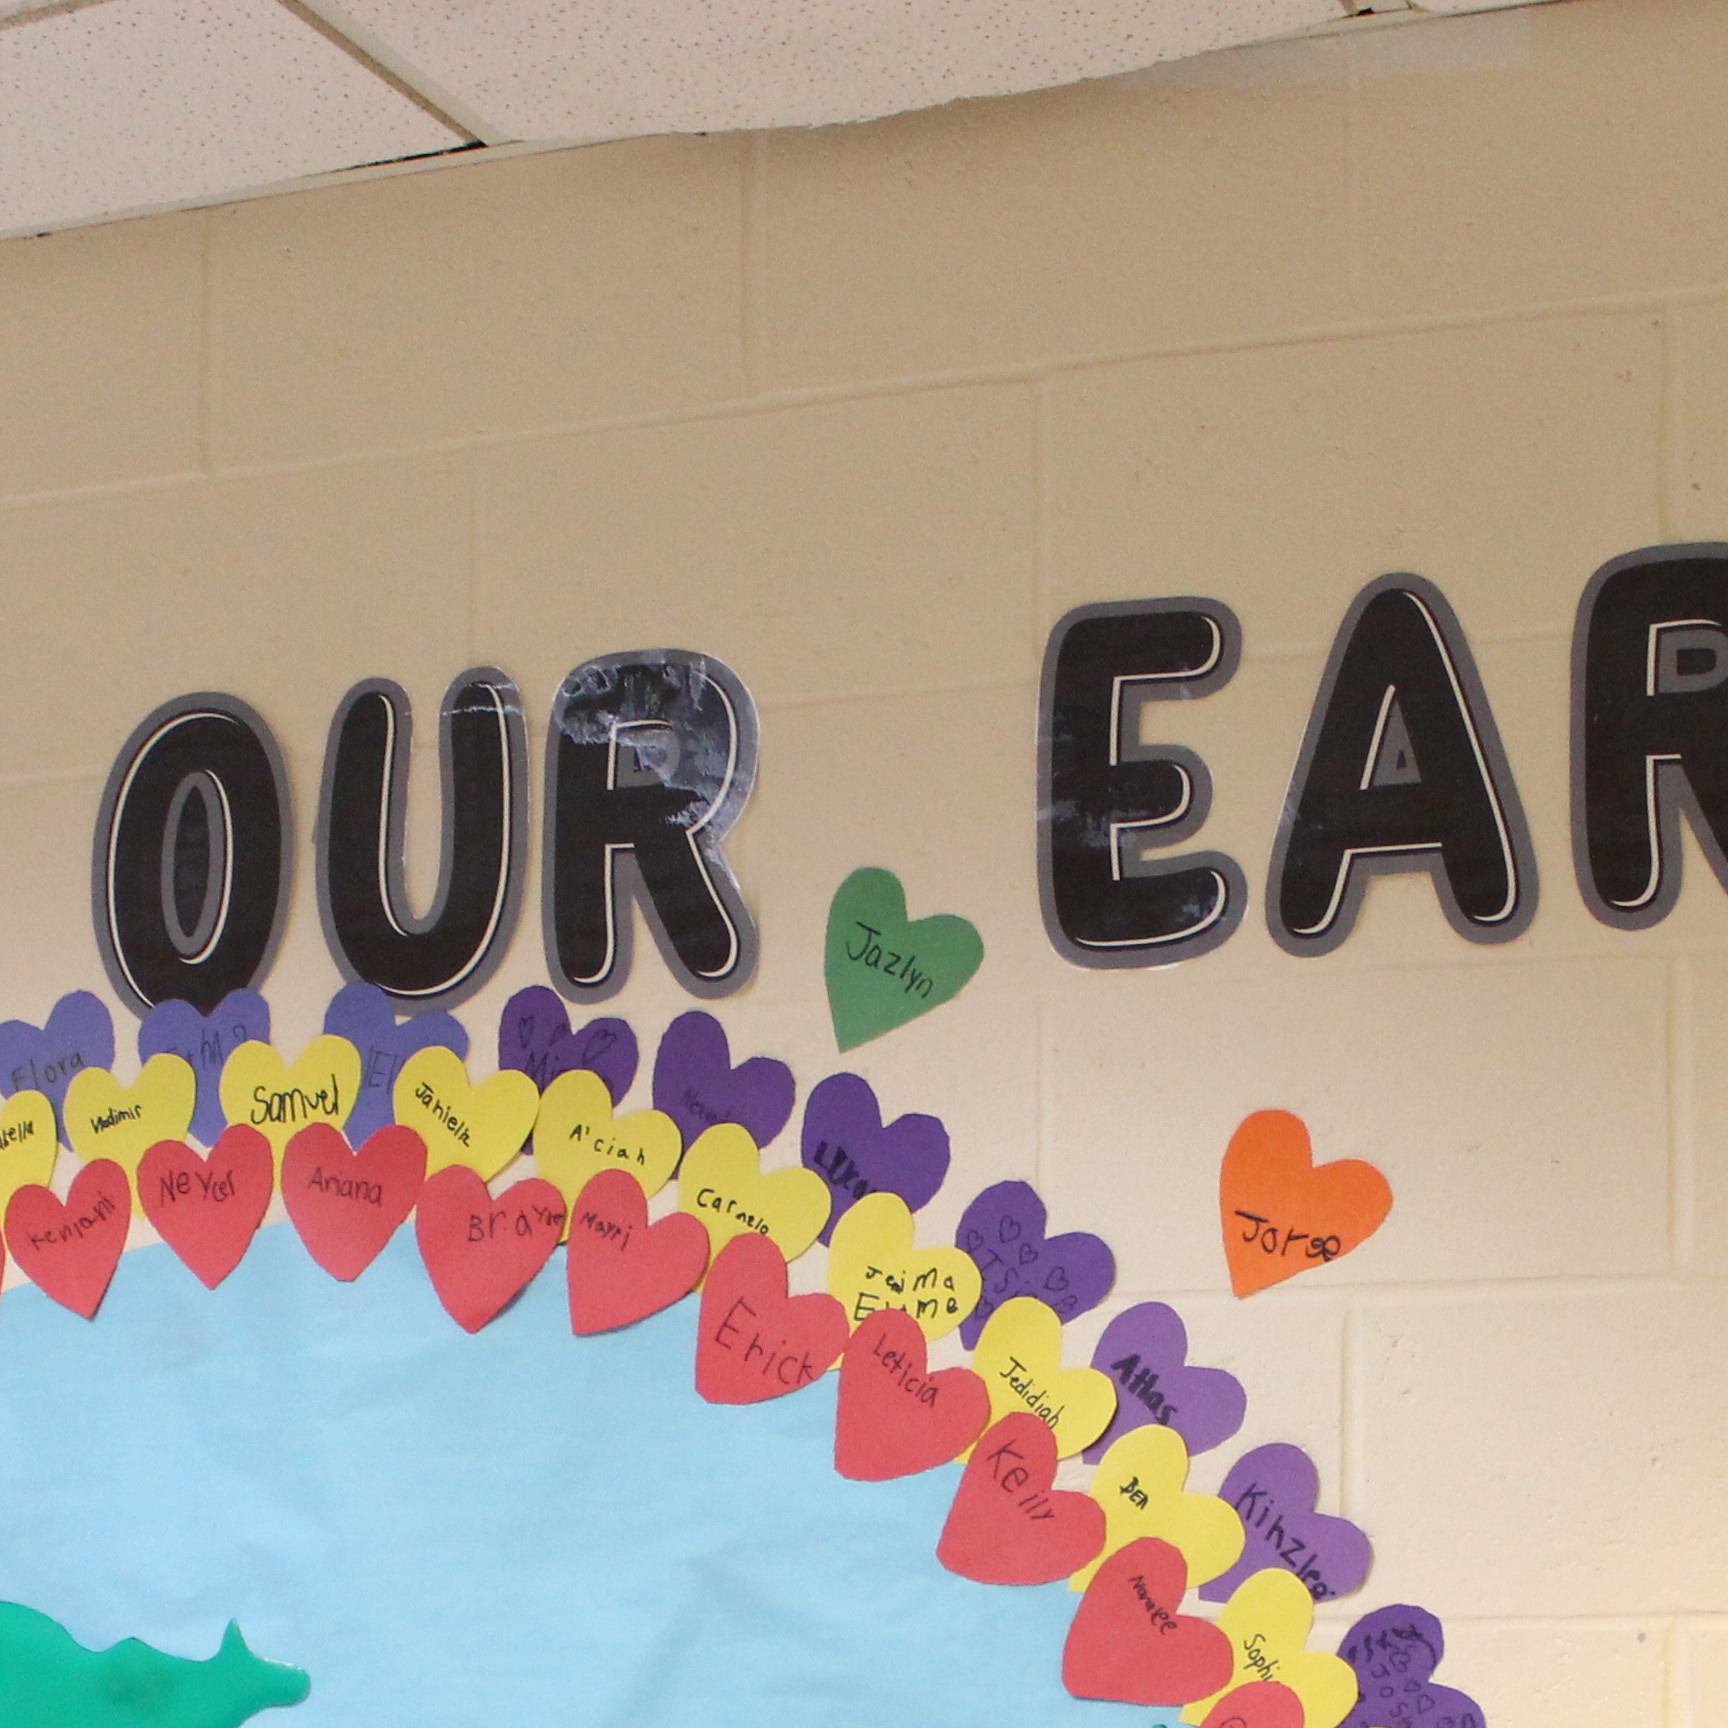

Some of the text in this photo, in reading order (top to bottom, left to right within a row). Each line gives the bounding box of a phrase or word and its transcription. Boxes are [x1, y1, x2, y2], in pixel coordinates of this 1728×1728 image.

[91, 648, 759, 1016] OUR
[845, 921, 933, 999] Jazlyn
[250, 1074, 341, 1126] Samuel
[308, 1167, 383, 1207] Ariana
[1234, 1209, 1342, 1262] Jorge
[715, 1296, 814, 1387] Erick
[874, 1333, 938, 1409] Leticia
[998, 1355, 1062, 1430] Jedidiah
